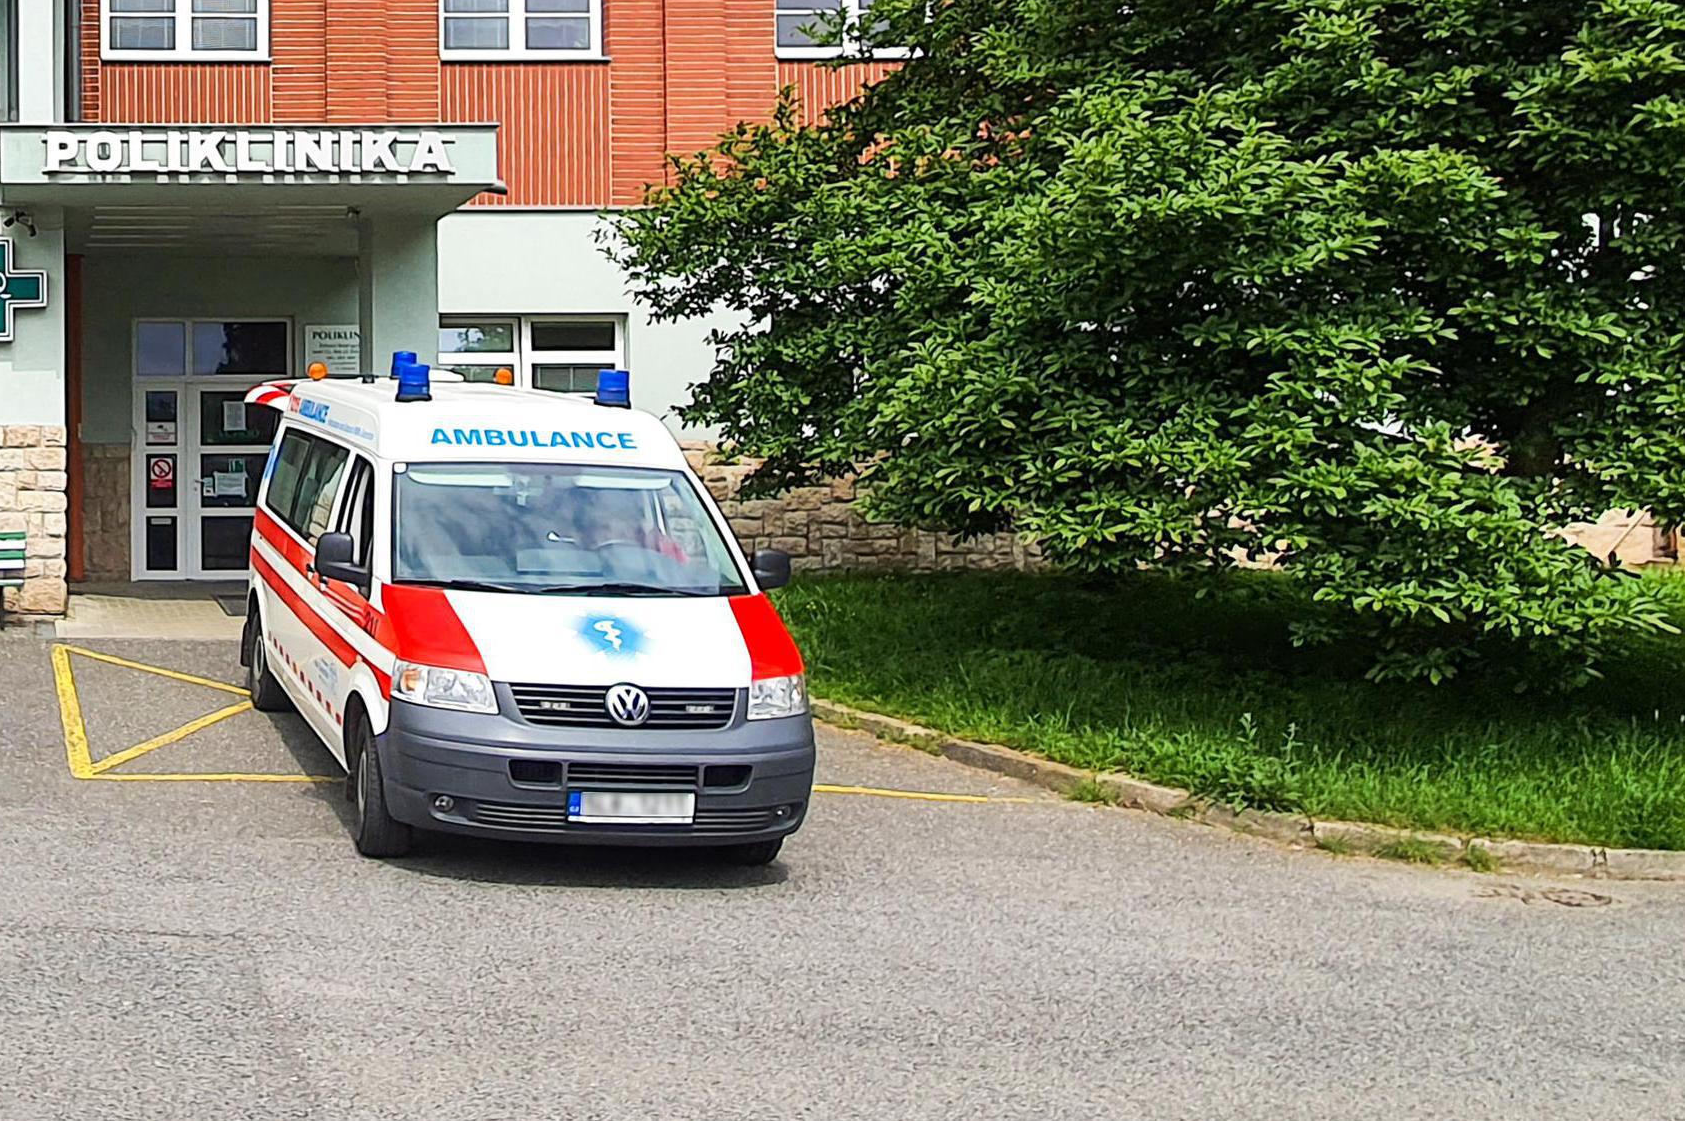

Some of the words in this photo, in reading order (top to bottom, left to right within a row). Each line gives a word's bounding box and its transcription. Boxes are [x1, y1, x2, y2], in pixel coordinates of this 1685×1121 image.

[45, 130, 452, 172] POLIKLINIKA
[312, 330, 360, 340] POLIKLIN
[430, 428, 638, 449] AMBULANCE
